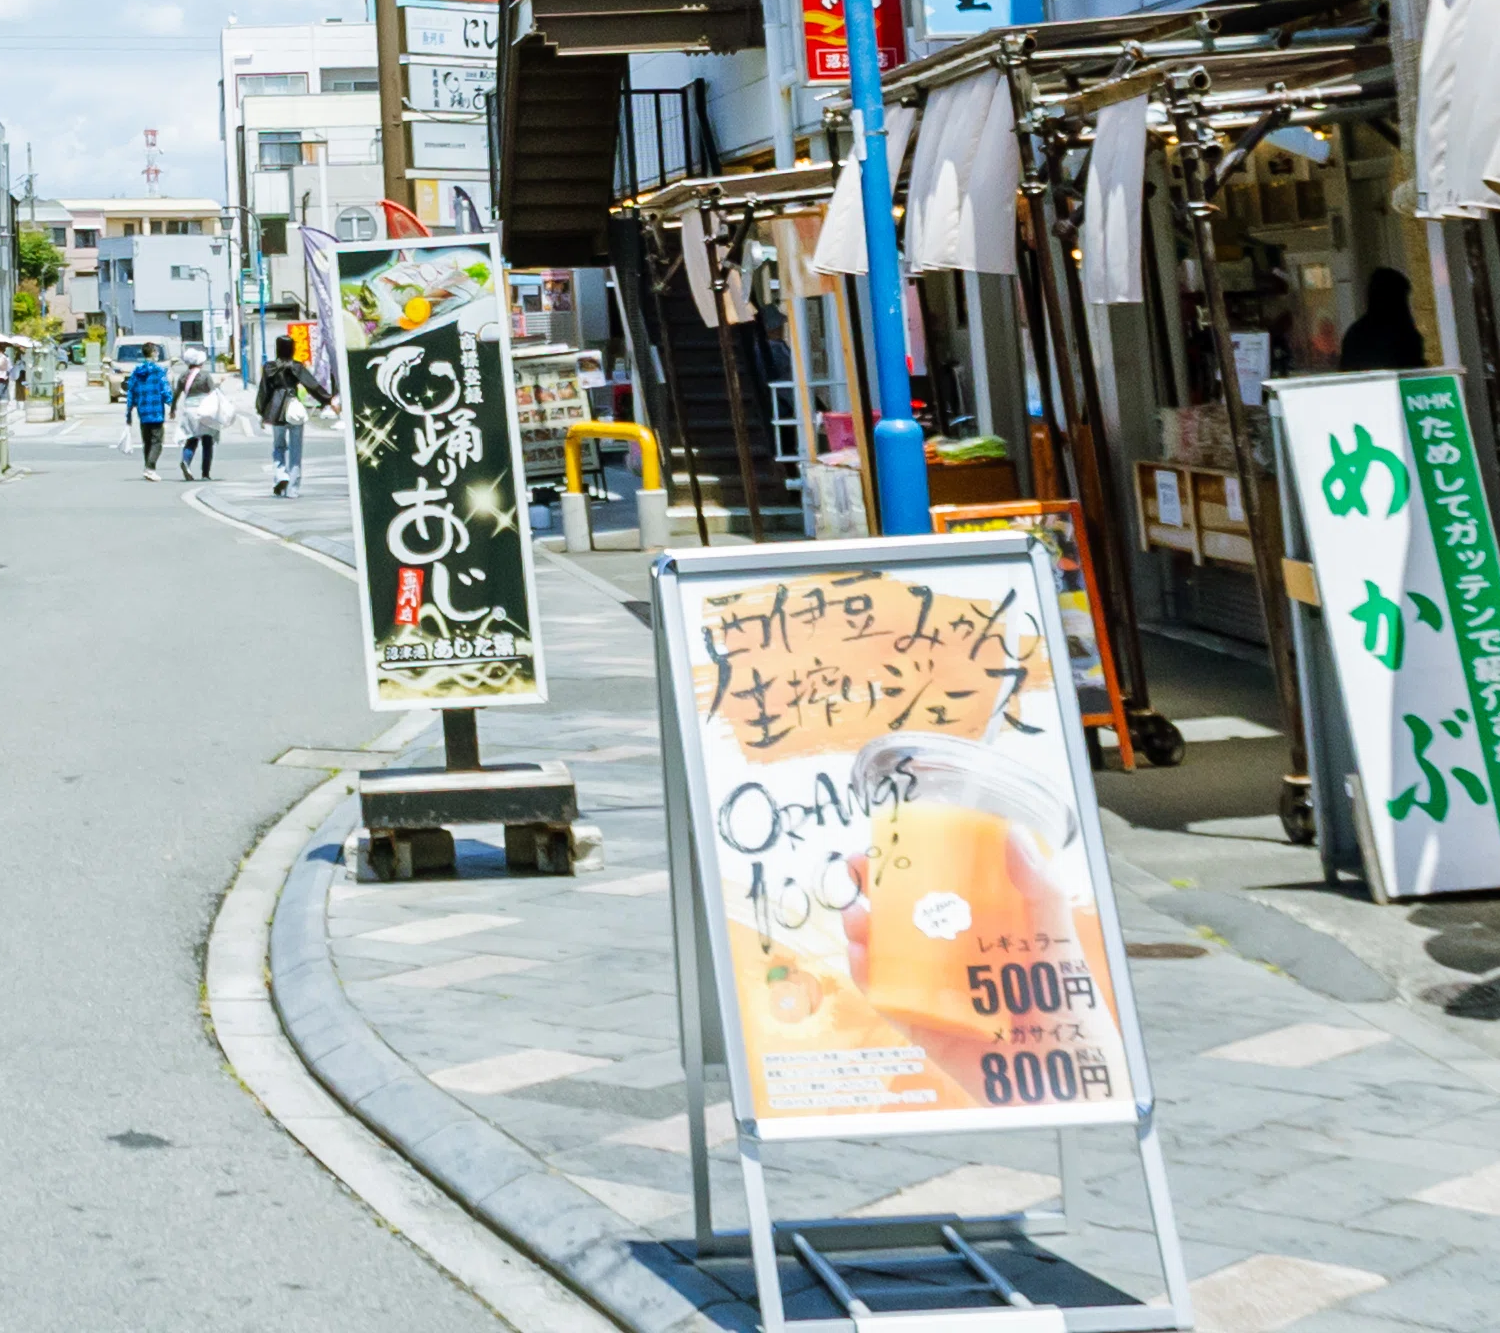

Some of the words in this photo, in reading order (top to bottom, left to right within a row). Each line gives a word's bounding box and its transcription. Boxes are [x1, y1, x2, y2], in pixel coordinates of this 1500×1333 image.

[462, 17, 498, 49] にし
[1406, 393, 1456, 412] NHK
[1322, 423, 1489, 822] めかぶ
[433, 634, 516, 660] あした葉
[706, 658, 1046, 748] 生搾りジュース
[977, 935, 1072, 954] レギュラー
[966, 961, 1097, 1016] 500円
[991, 1022, 1085, 1045] メガサイズ
[980, 1049, 1114, 1105] 800円
